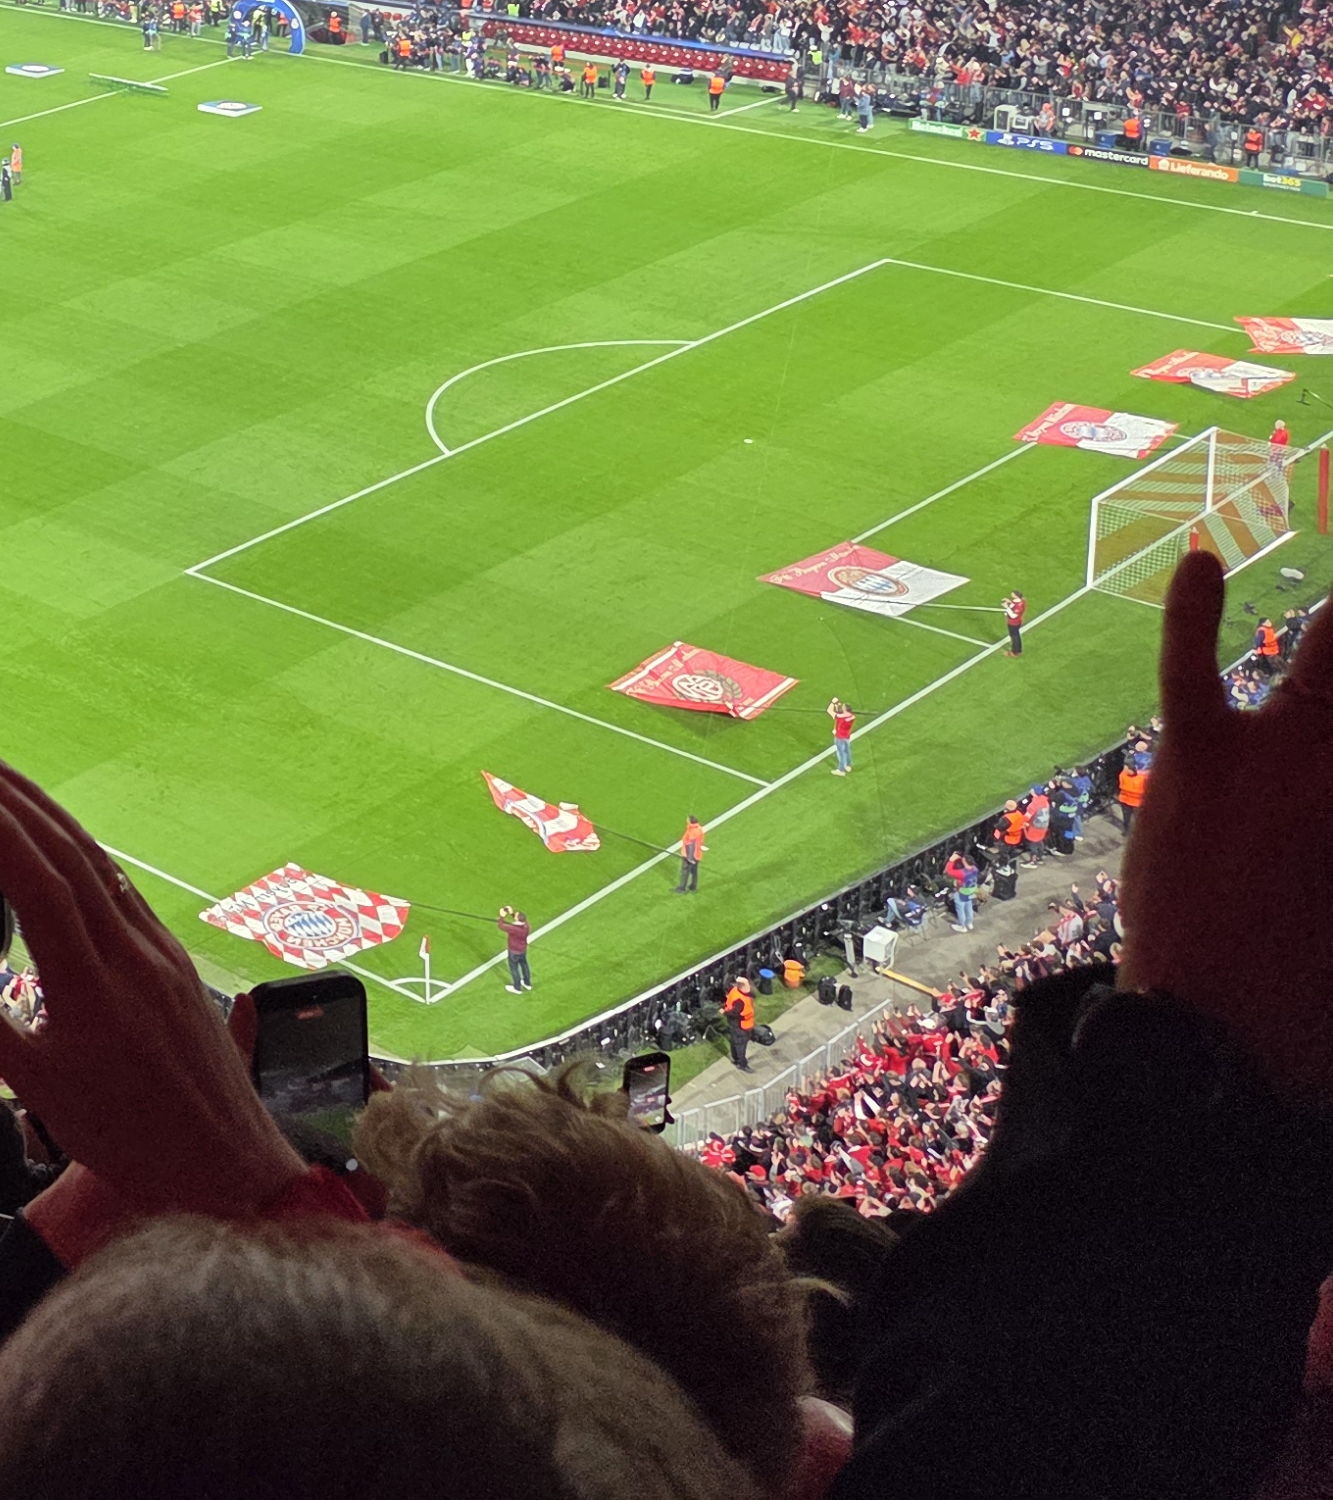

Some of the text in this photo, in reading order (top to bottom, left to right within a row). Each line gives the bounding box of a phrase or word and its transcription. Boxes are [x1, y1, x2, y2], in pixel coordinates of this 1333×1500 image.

[1017, 136, 1054, 151] PS5
[1084, 148, 1149, 167] mastercard
[1170, 162, 1230, 181] Lieferando
[1263, 173, 1302, 187] bet365
